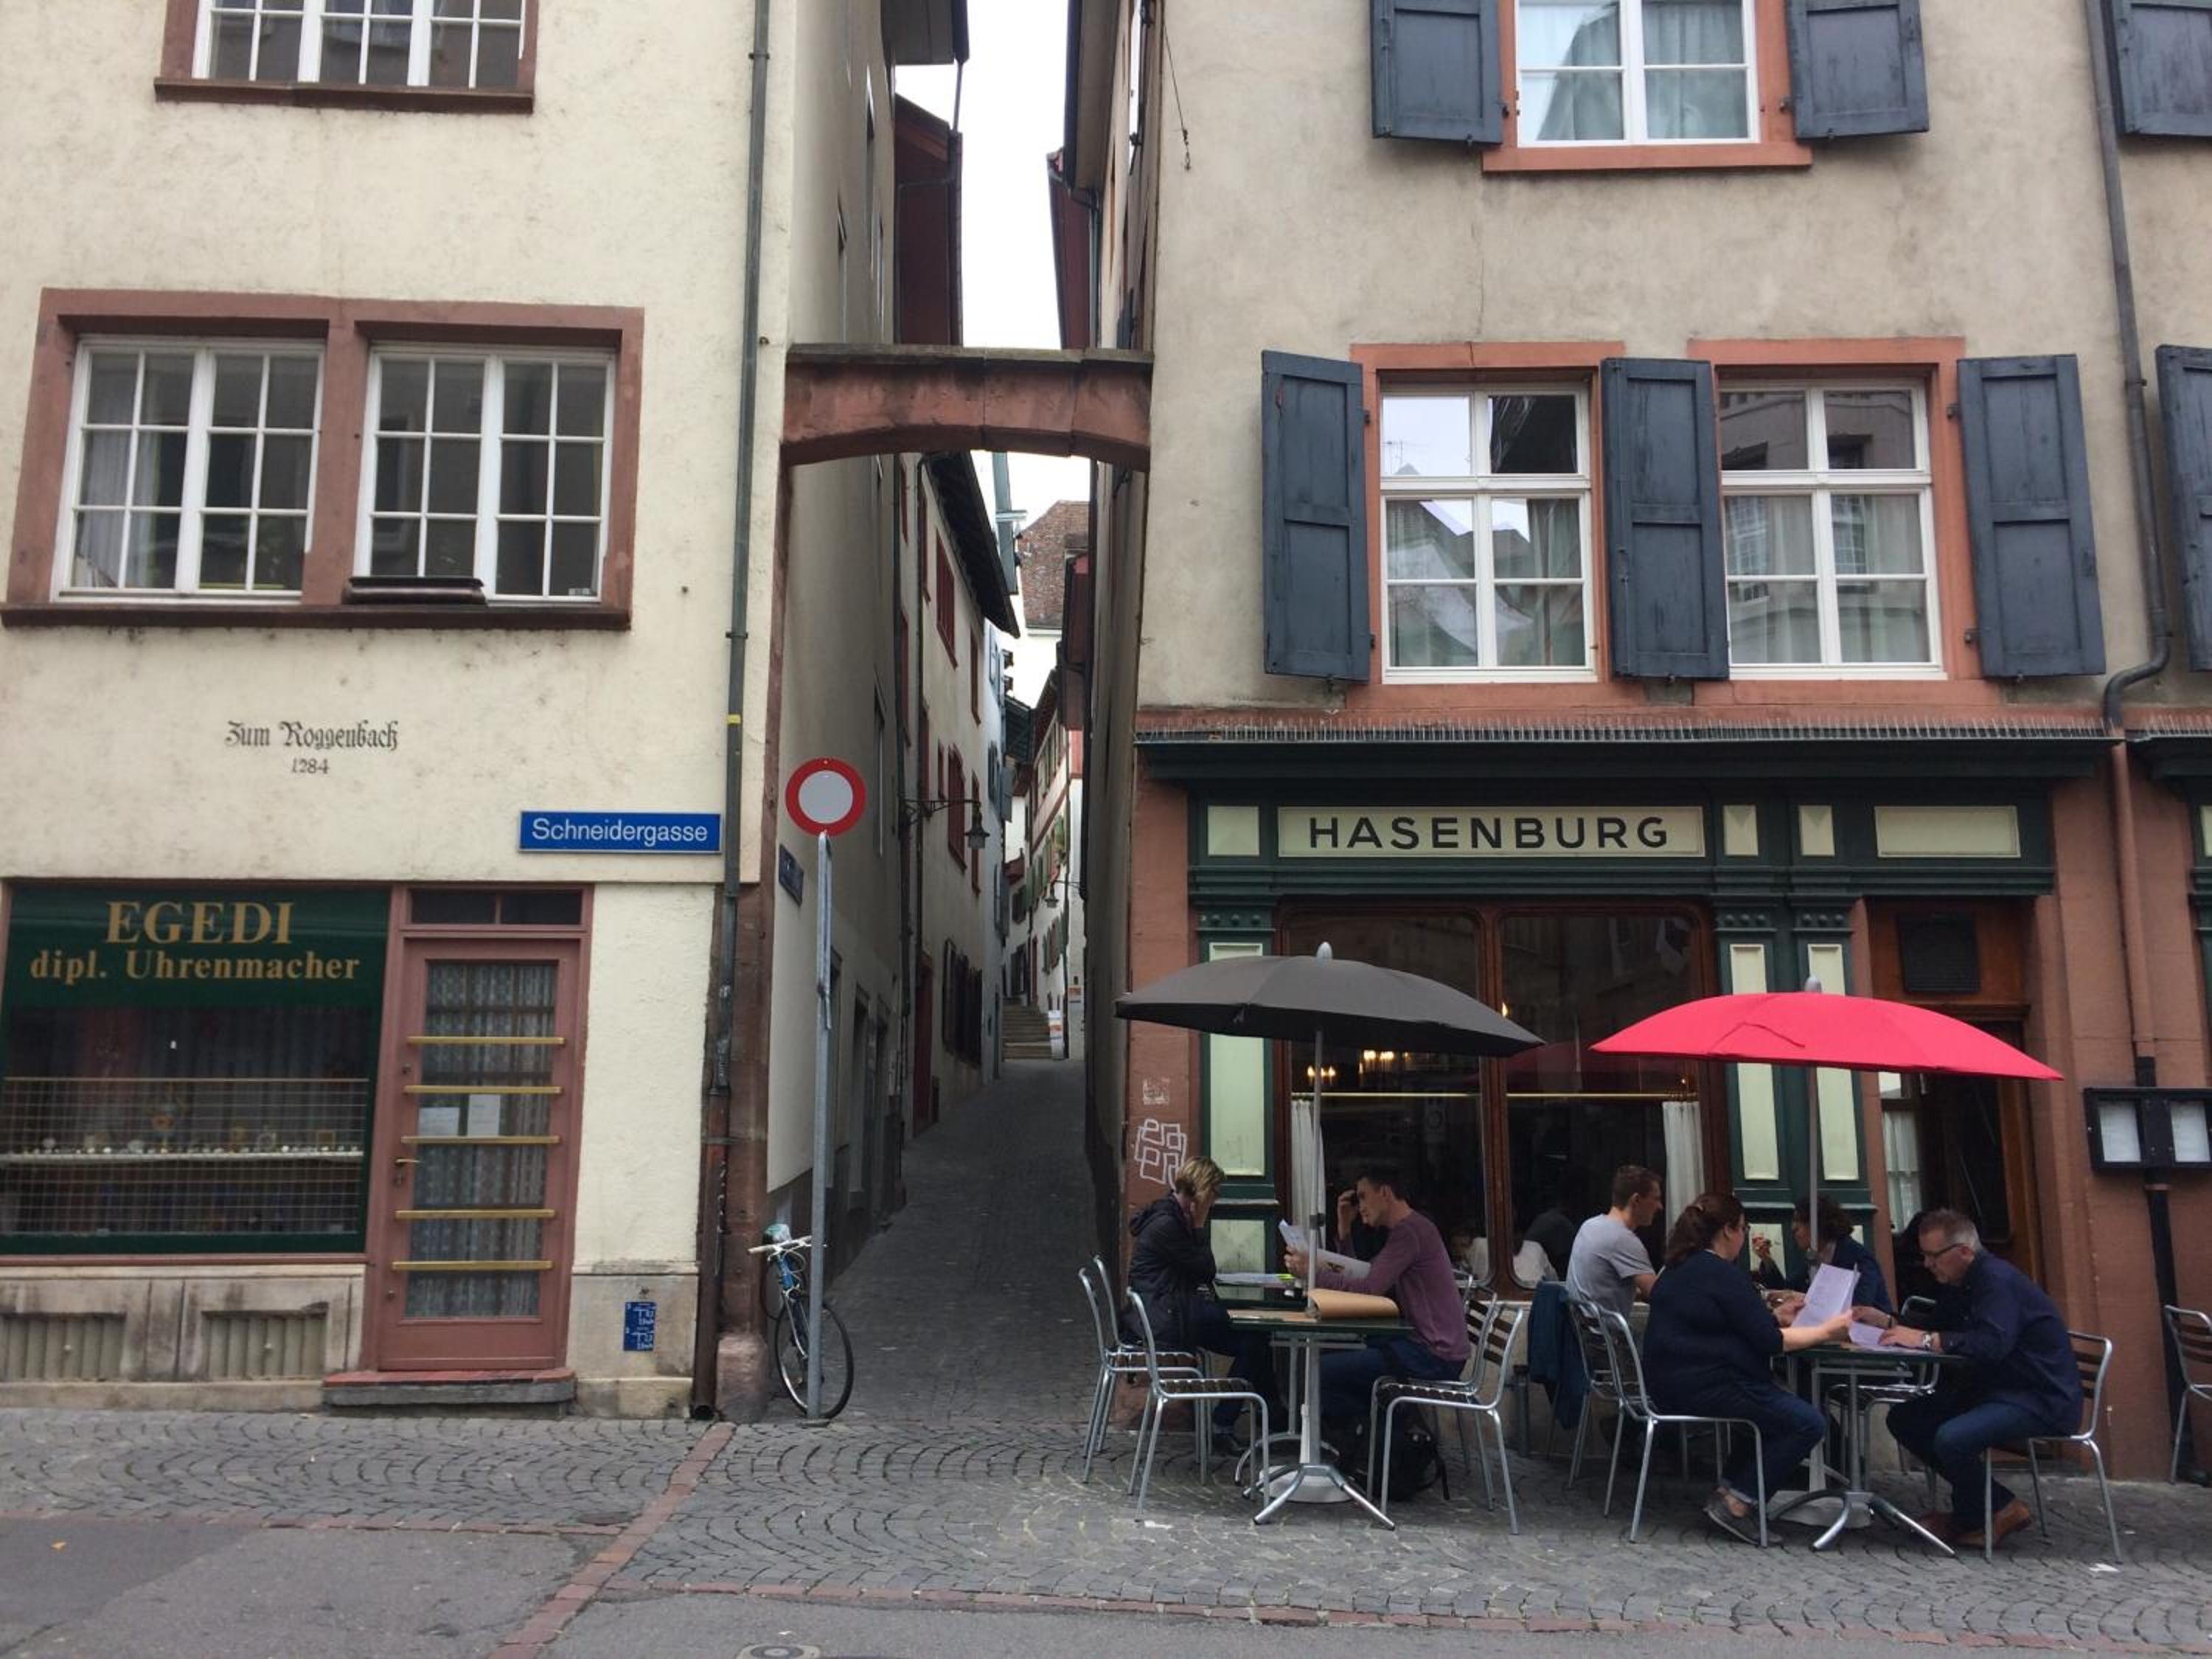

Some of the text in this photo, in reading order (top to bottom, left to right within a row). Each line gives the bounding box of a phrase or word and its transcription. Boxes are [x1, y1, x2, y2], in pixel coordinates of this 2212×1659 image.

[225, 721, 398, 751] Zum Roggenbach
[291, 758, 330, 774] 1284
[531, 818, 709, 846] Schneidergasse
[1310, 816, 1669, 850] HASENBURG
[106, 901, 294, 945] EGEDI
[30, 950, 360, 984] dipl. Uhrenmacher
